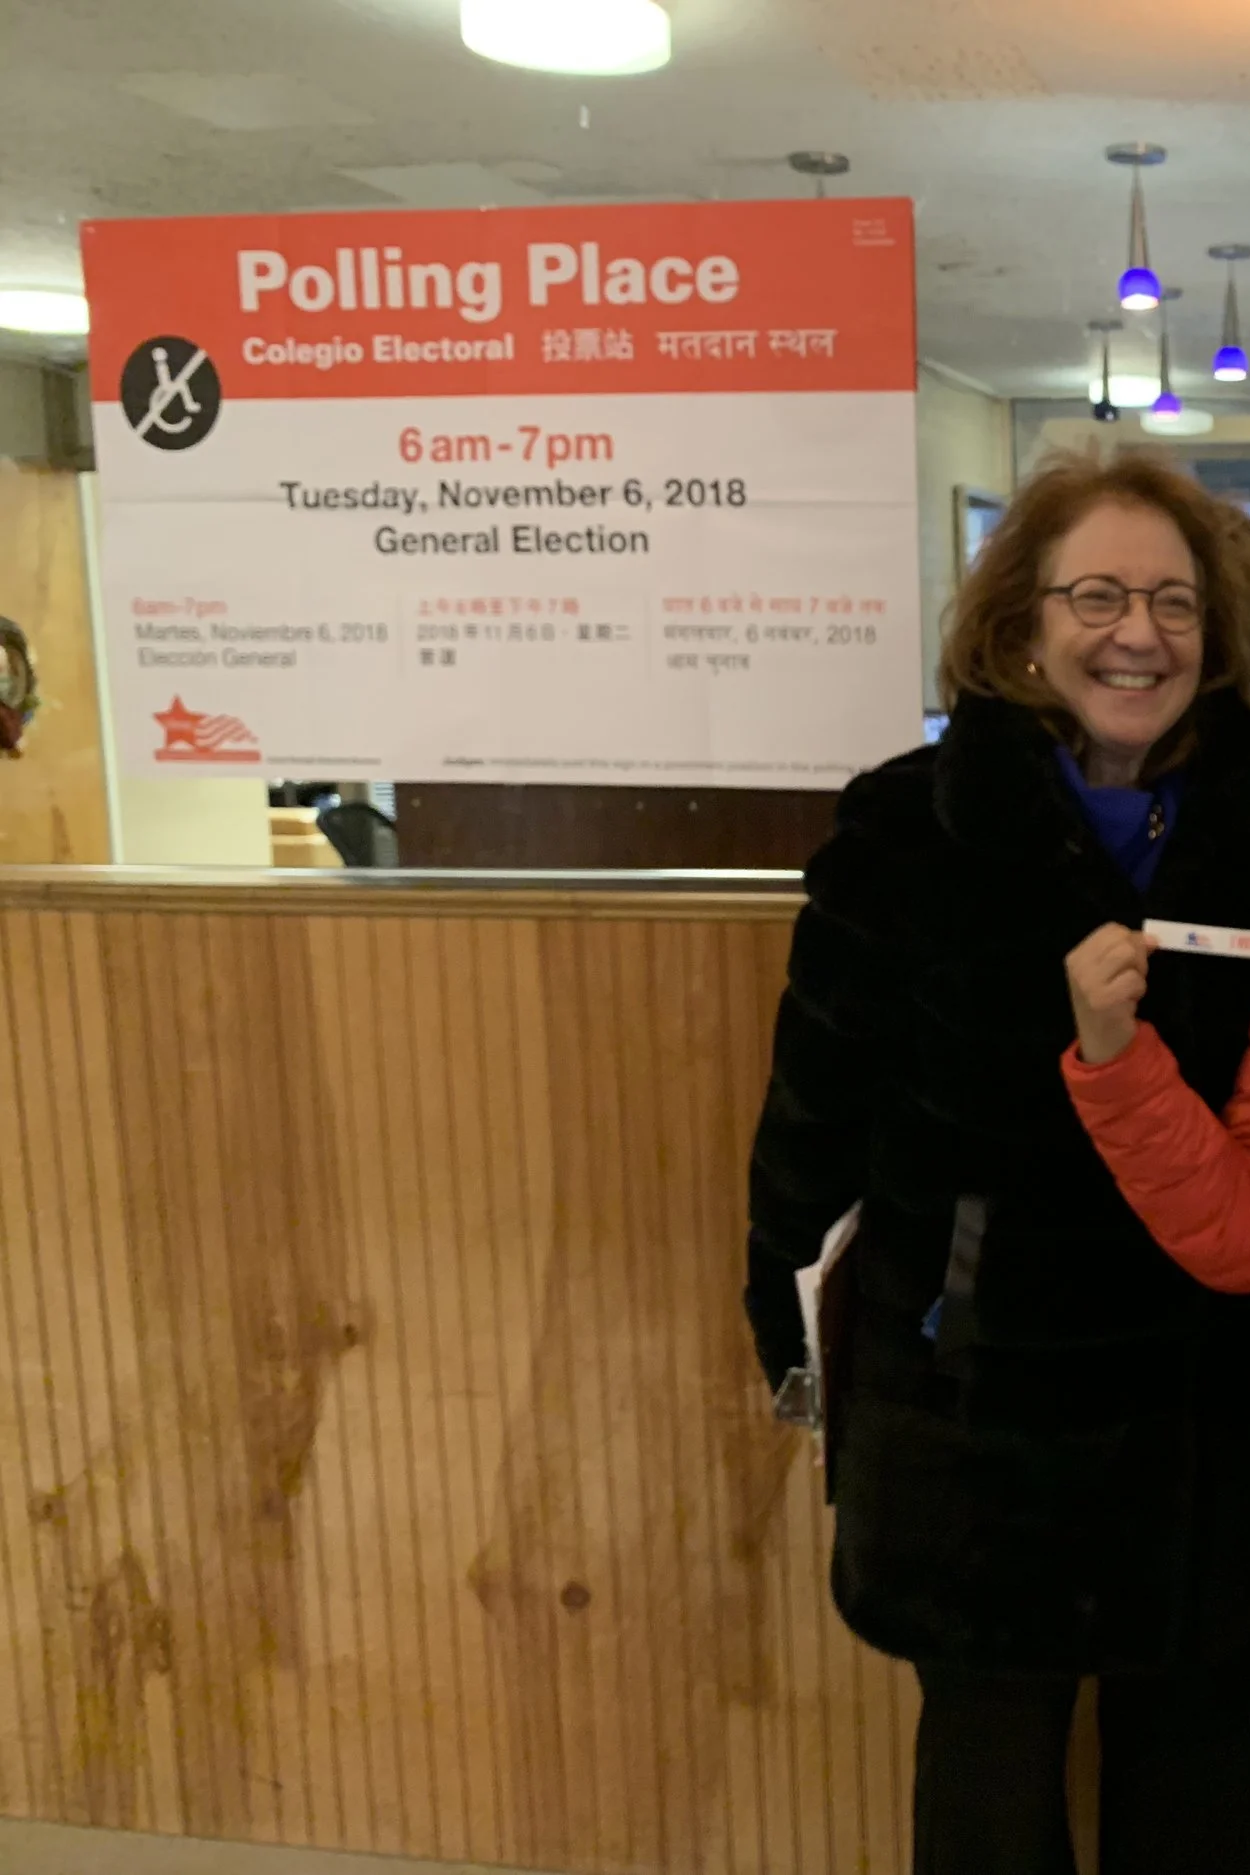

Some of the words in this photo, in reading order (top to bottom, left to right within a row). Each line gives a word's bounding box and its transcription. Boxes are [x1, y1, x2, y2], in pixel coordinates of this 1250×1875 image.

[237, 247, 502, 323] Polling
[527, 241, 740, 307] Place
[241, 336, 364, 369] Colegio
[372, 333, 514, 364] Electoral
[656, 330, 758, 360] मतदान
[767, 328, 838, 358] स्थल
[398, 424, 616, 469] 6am-7pm
[279, 480, 429, 514] Tuesday,
[438, 479, 609, 509] November
[622, 478, 653, 512] 6,
[664, 478, 747, 508] 2018
[375, 525, 500, 555] General
[513, 525, 650, 554] Election
[340, 622, 390, 643] 2018
[826, 623, 878, 645] 2018
